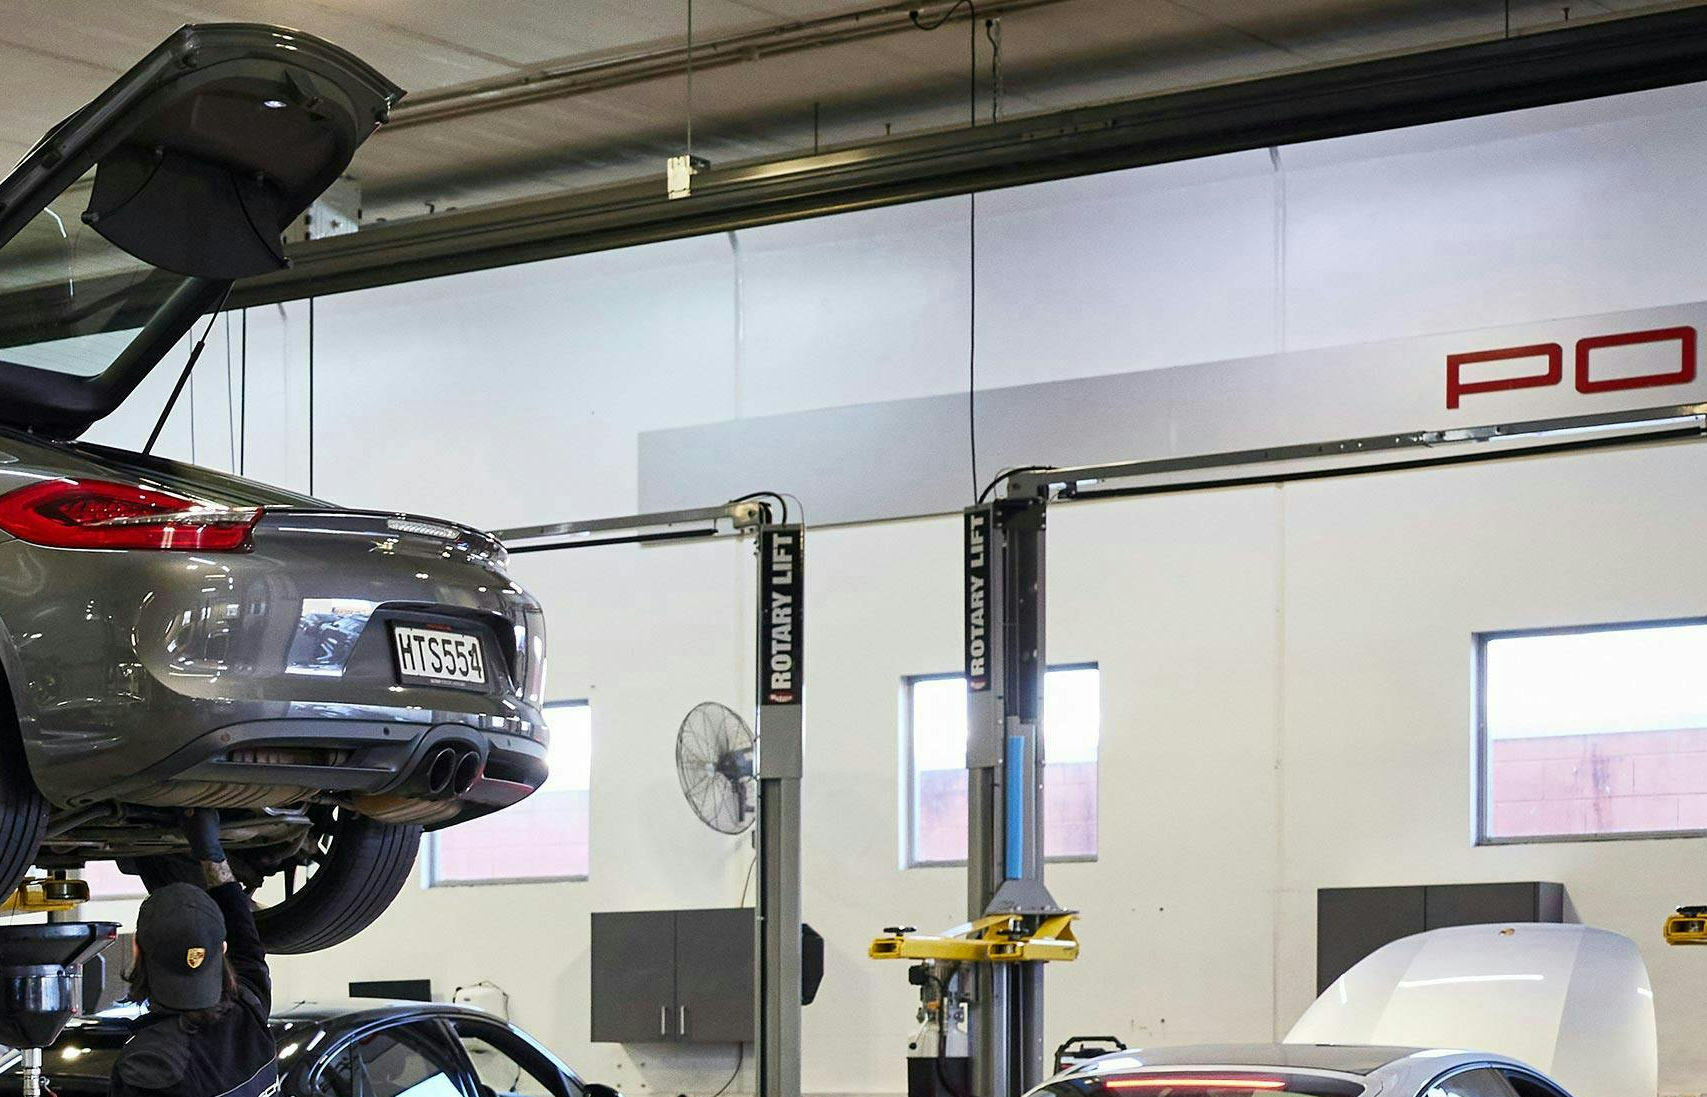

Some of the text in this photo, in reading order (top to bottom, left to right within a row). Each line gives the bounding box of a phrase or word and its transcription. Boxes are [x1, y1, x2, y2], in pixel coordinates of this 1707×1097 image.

[970, 514, 985, 569] LIFT
[771, 532, 793, 690] ROTARY LIFT
[971, 576, 985, 677] ROTARY
[398, 633, 483, 679] HTS554
